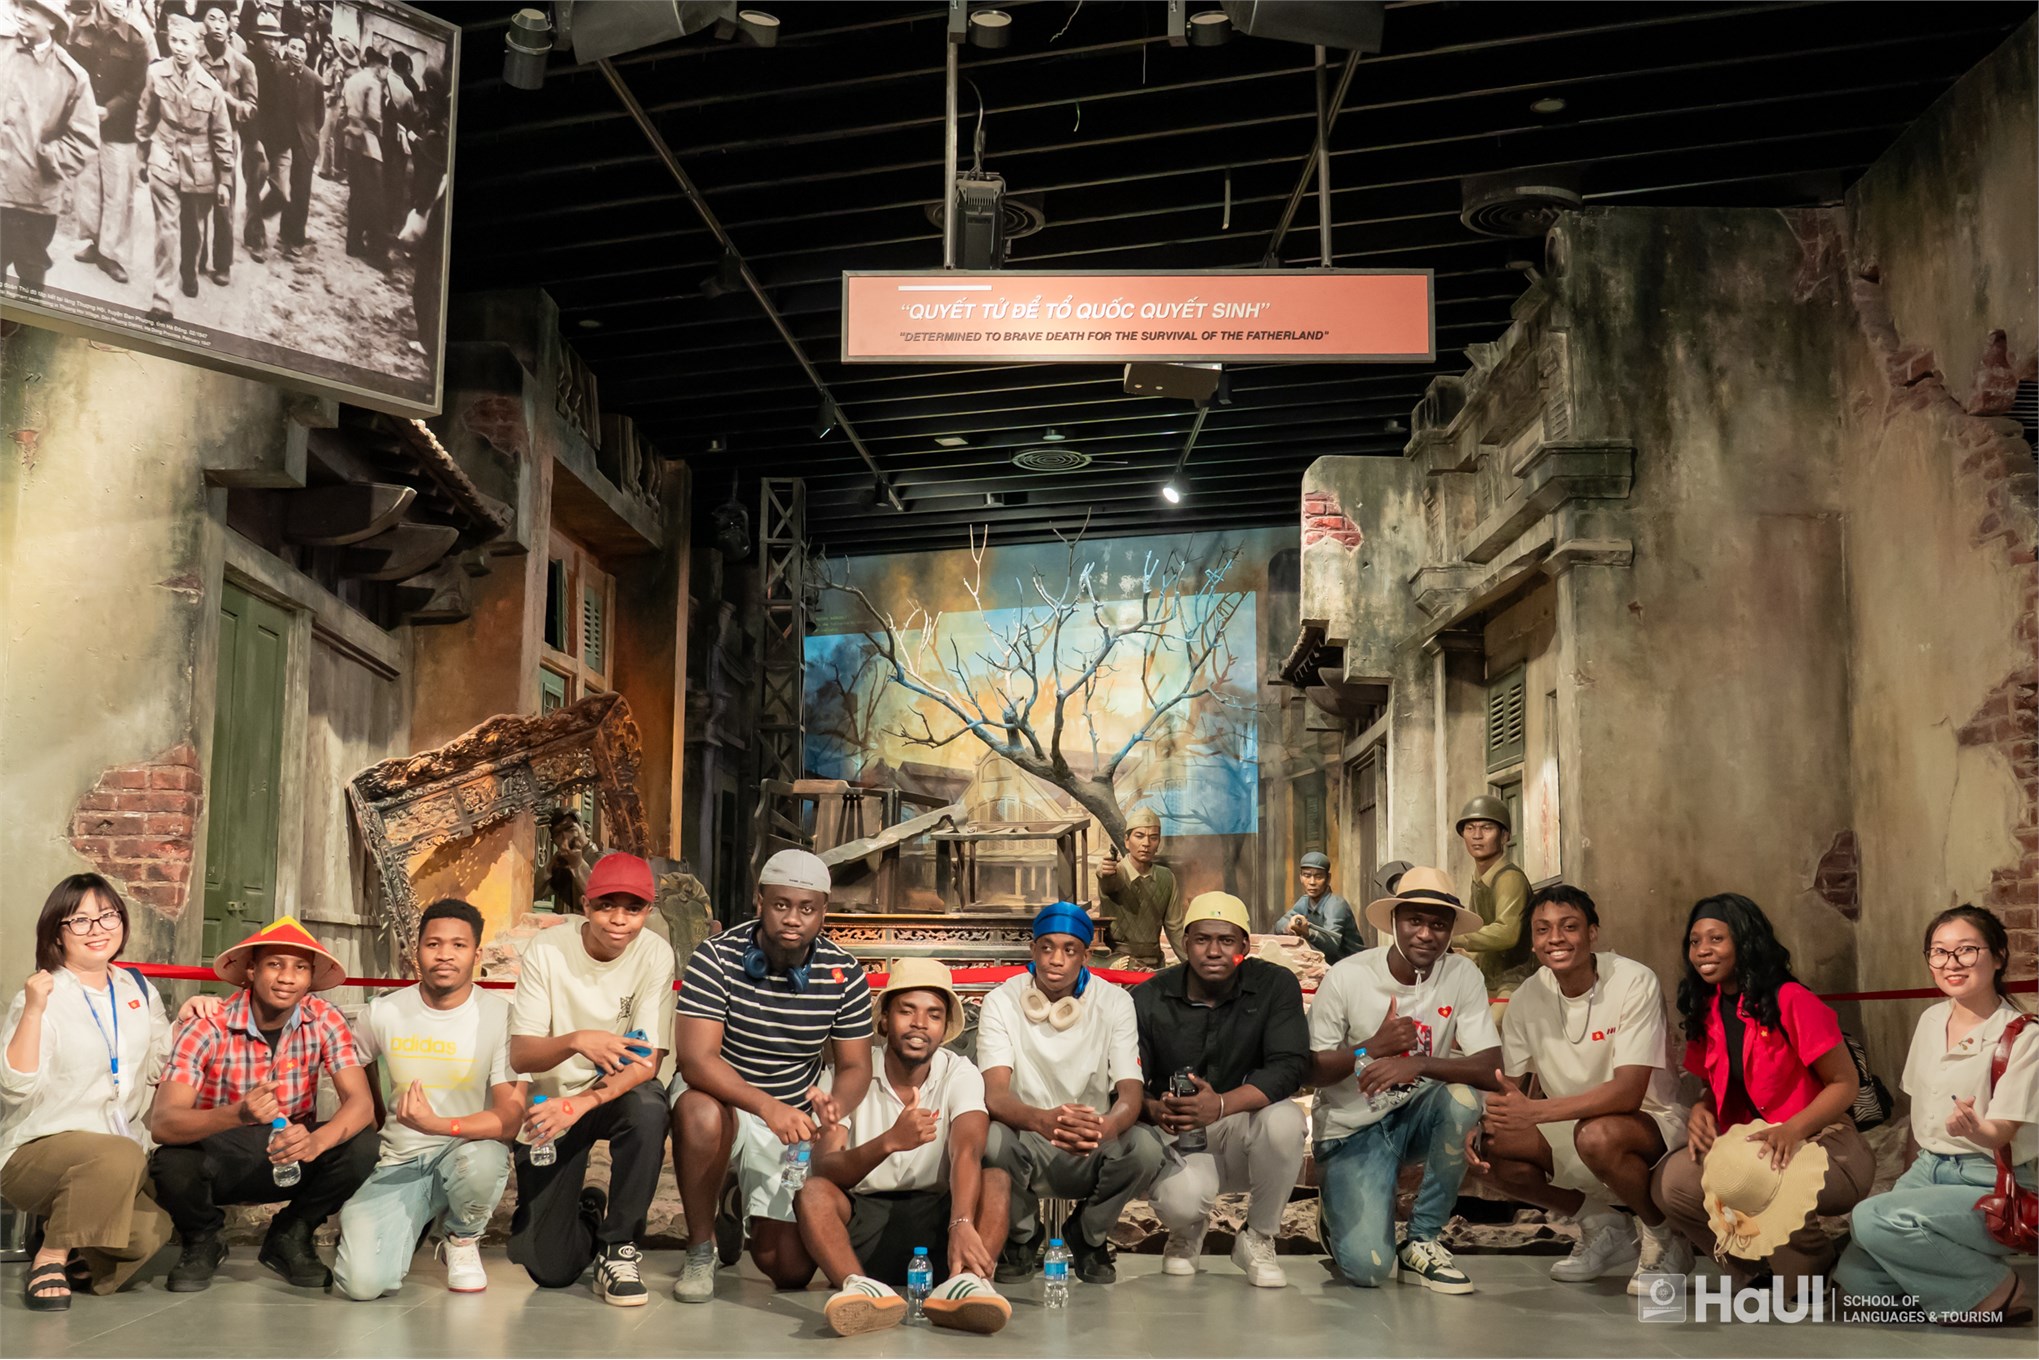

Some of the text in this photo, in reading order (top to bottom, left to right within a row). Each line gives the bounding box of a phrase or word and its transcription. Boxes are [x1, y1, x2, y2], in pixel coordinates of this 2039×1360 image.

[982, 296, 1008, 320] TỬ
[1012, 295, 1042, 319] ĐỂ
[1046, 295, 1073, 320] TỔ
[1076, 297, 1136, 320] QUỐC
[1140, 296, 1208, 319] QUYẾT
[985, 332, 1001, 341] TO
[1003, 332, 1043, 341] BRAVE
[1045, 332, 1085, 341] DEATH
[1087, 331, 1112, 341] FOR
[1115, 331, 1138, 341] THE
[1140, 331, 1198, 341] SURVIVAL
[1201, 331, 1218, 341] OF
[1221, 331, 1244, 341] THE
[391, 1034, 456, 1055] adidas
